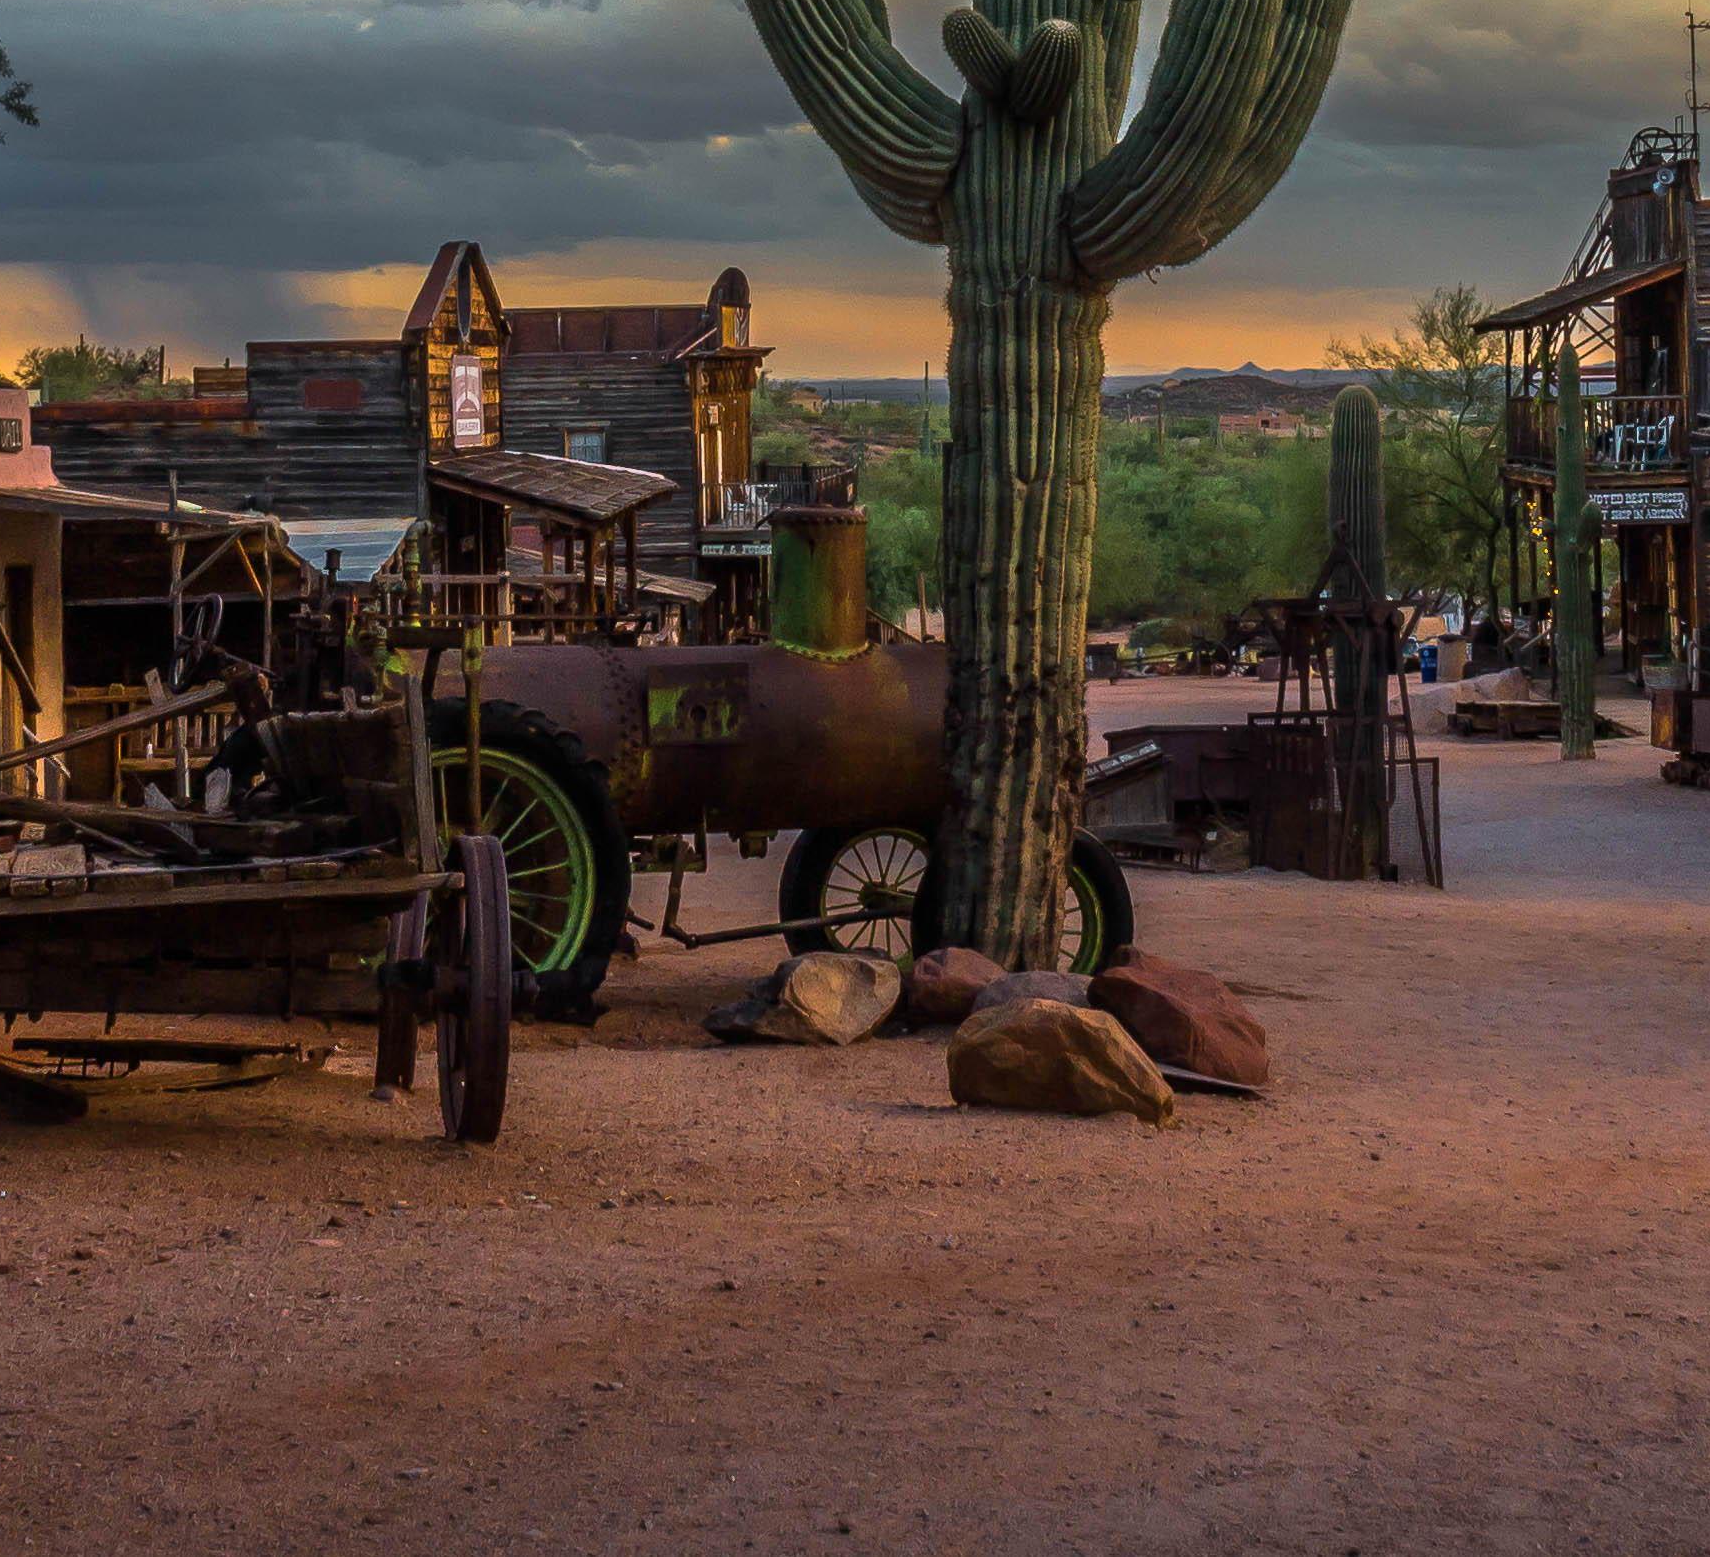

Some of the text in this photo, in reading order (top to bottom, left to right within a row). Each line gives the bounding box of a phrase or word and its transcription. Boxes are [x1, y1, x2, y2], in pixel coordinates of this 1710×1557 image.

[1589, 494, 1624, 505] VOTED
[1625, 493, 1650, 504] BEST
[1611, 510, 1633, 520] SHOP
[1634, 510, 1645, 520] IN
